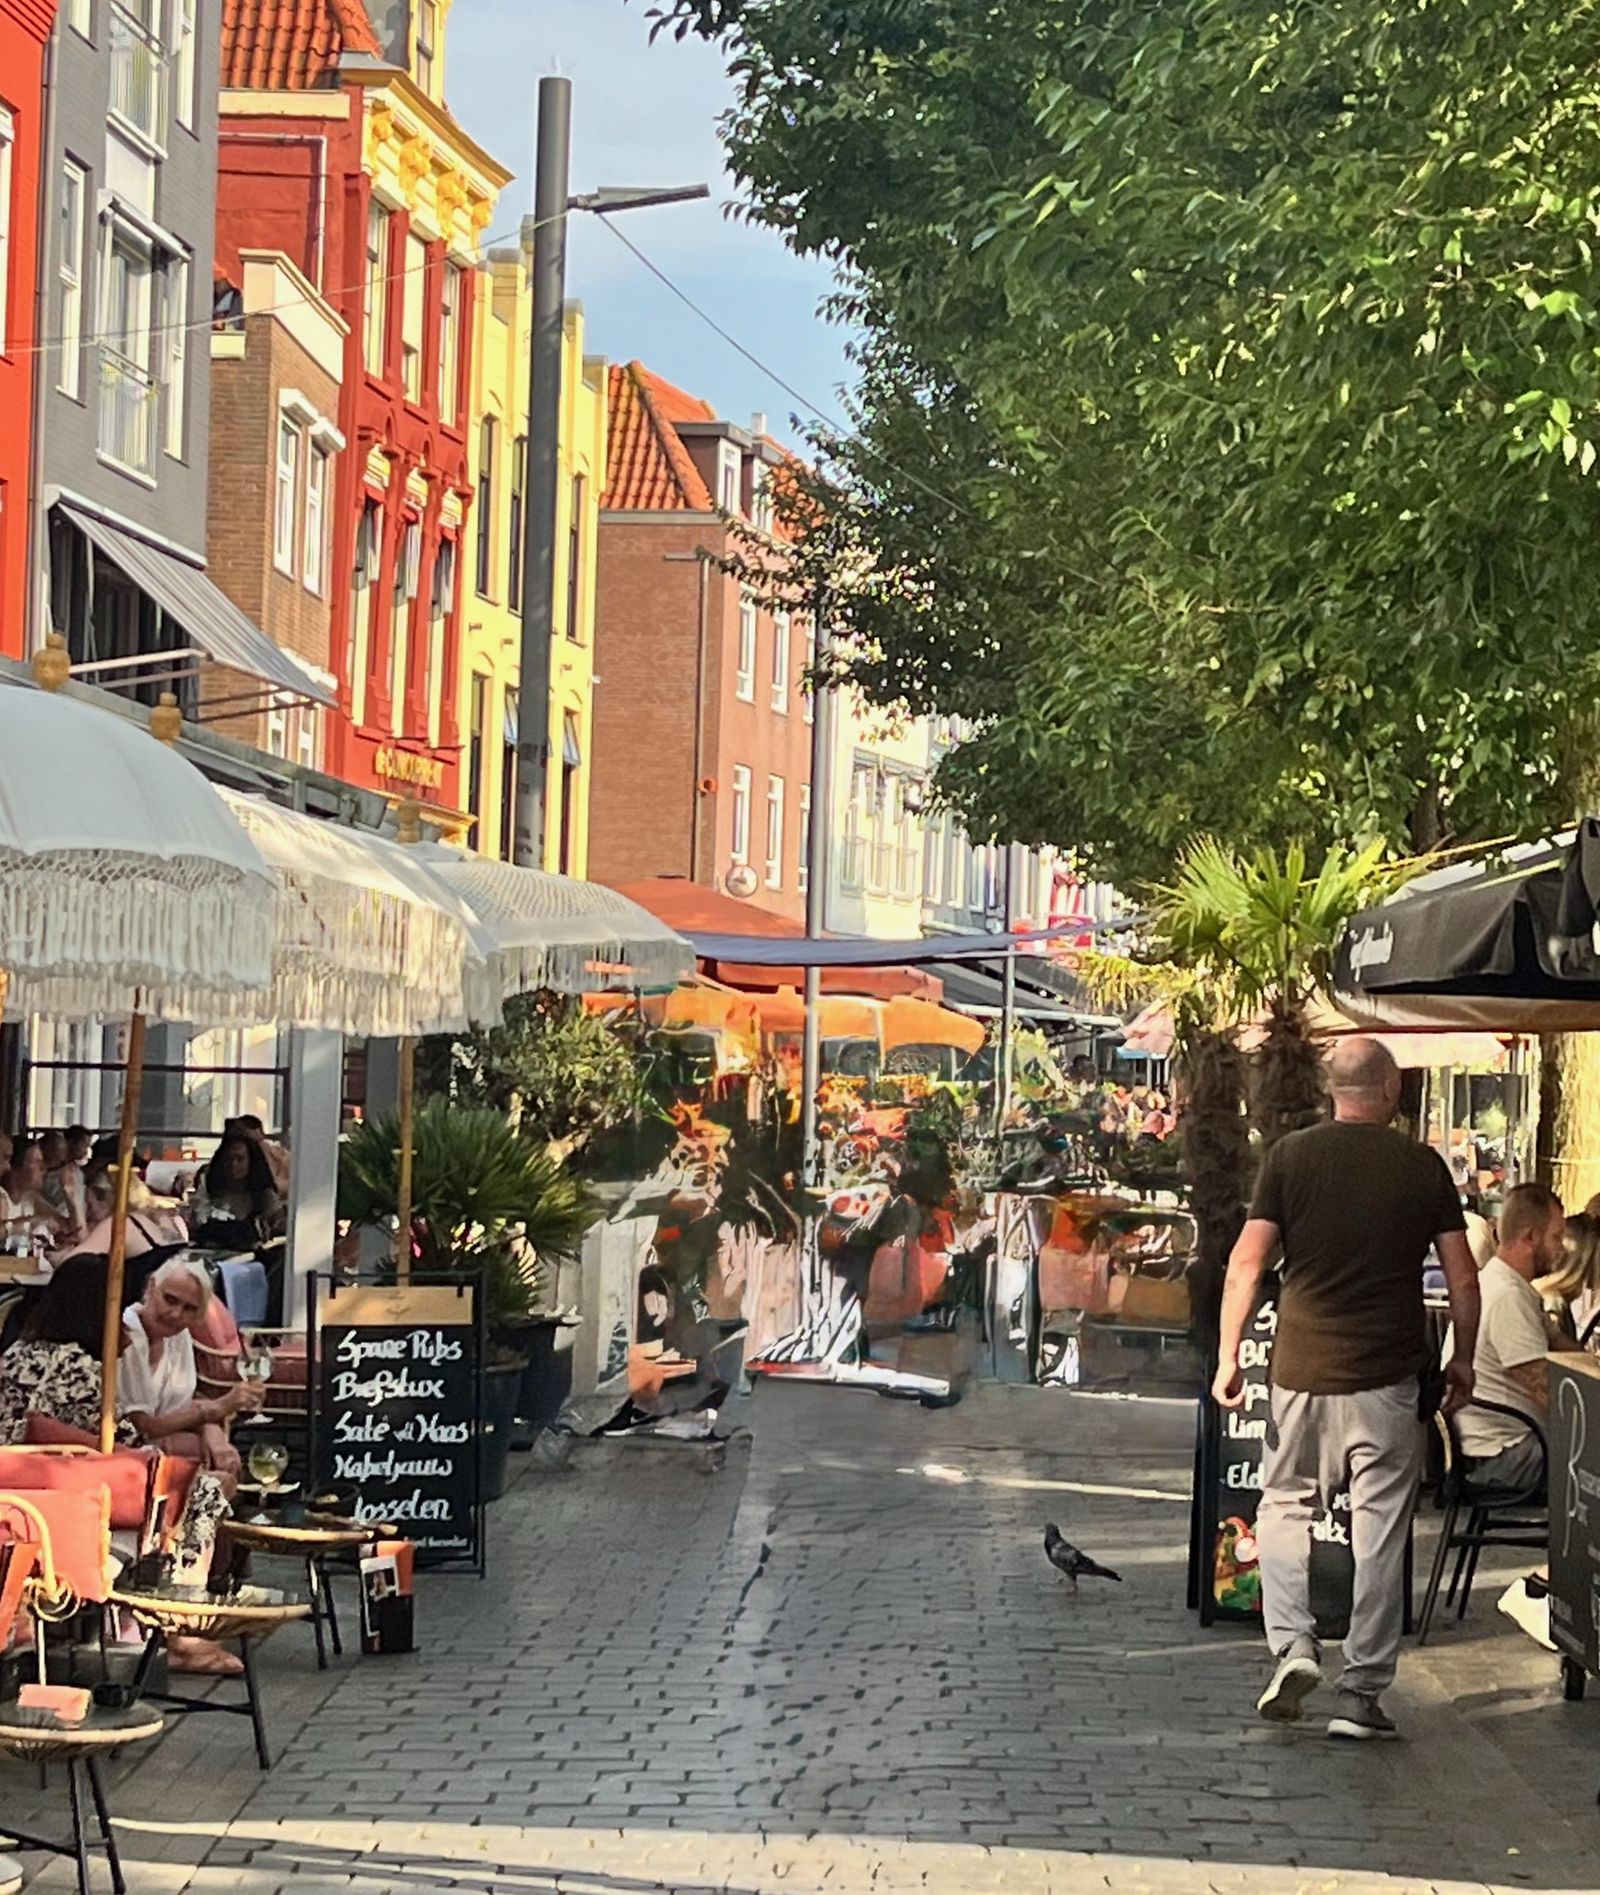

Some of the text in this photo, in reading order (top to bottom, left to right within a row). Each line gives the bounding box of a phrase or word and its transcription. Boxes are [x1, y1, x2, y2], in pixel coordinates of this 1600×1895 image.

[336, 1329, 463, 1368] Spare Ribs
[333, 1450, 453, 1484] Kabeljauw
